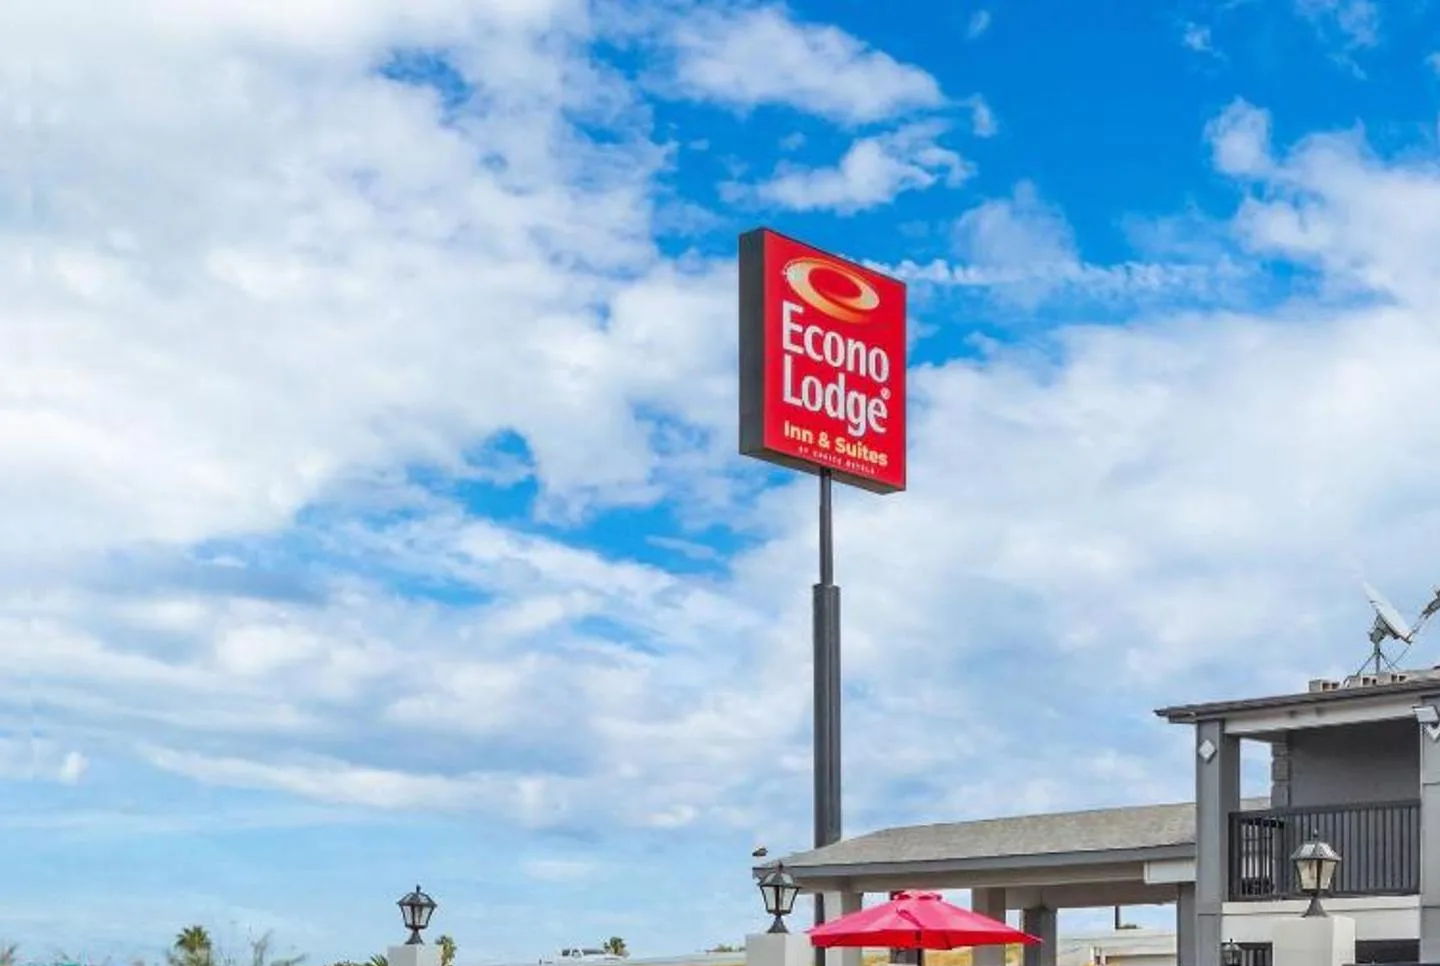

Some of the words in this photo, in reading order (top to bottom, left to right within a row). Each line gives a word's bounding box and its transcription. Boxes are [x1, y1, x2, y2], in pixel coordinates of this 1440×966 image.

[783, 300, 889, 383] Econo
[783, 353, 888, 437] Lodge
[784, 420, 814, 445] Inn
[818, 431, 831, 450] &
[835, 436, 888, 466] Suites
